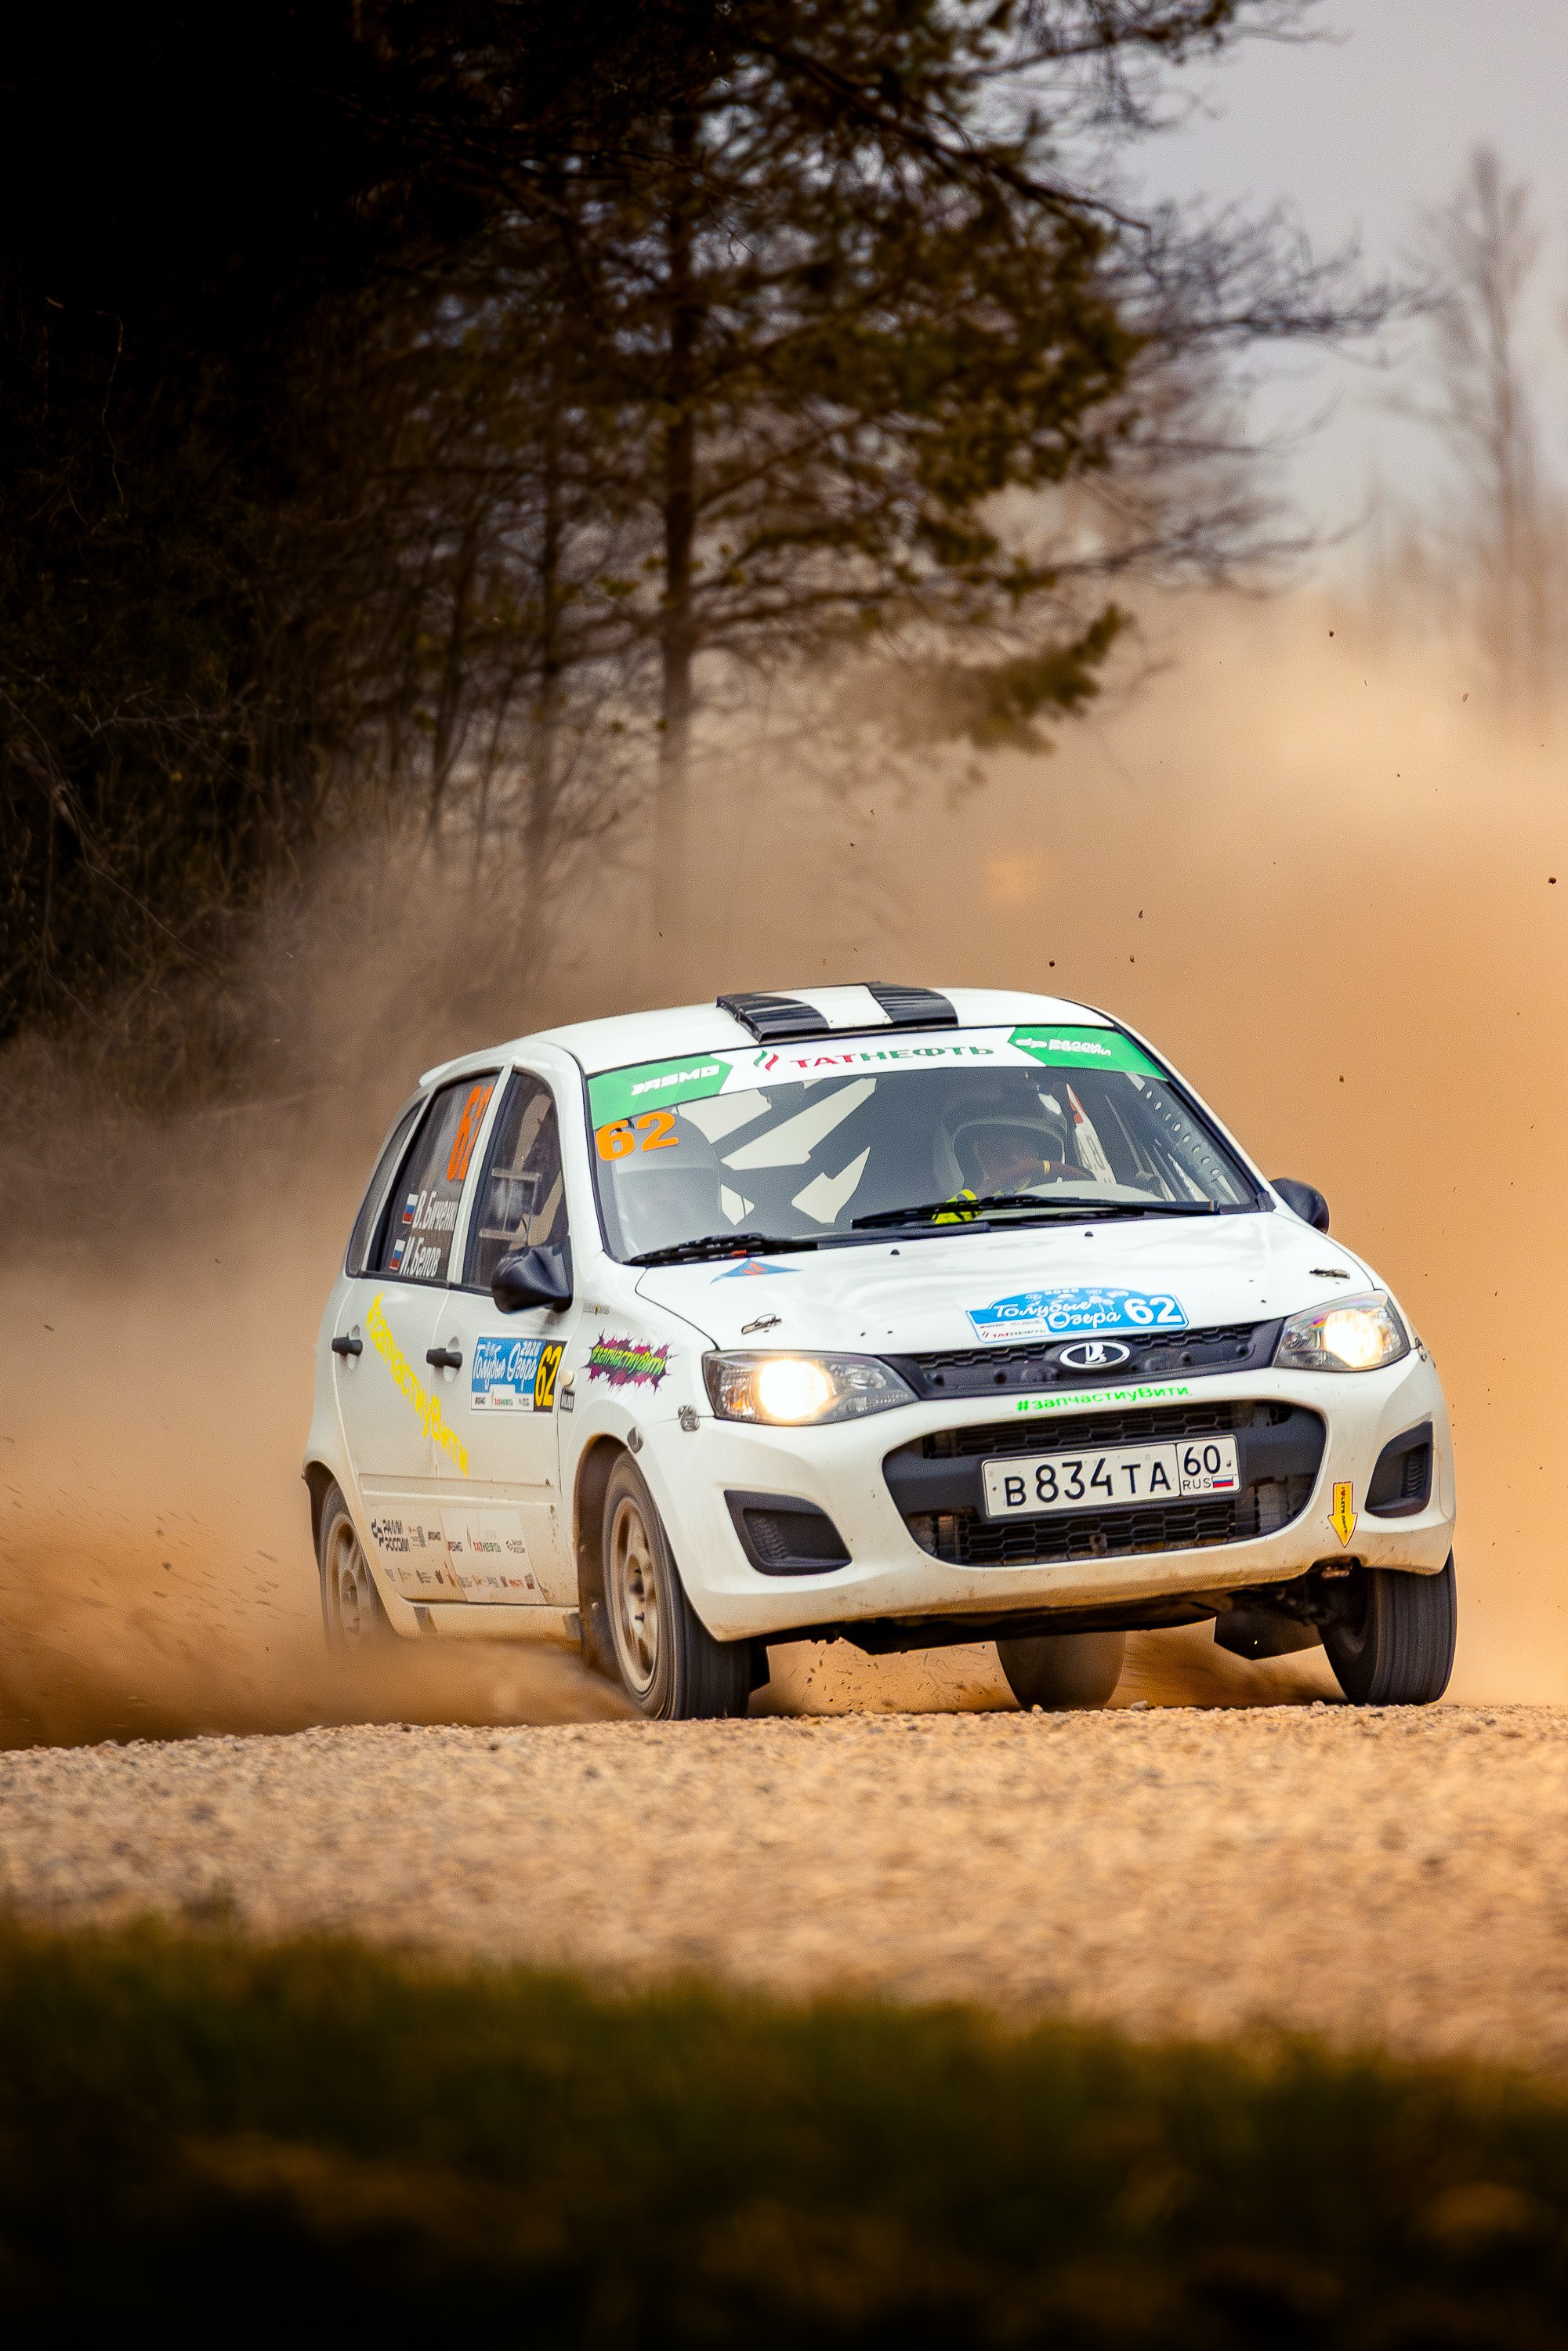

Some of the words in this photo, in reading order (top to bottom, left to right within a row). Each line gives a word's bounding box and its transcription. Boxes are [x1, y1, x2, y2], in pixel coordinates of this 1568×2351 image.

[790, 1045, 994, 1069] ТАТНЕФТЬ
[596, 1111, 681, 1161] 62
[1124, 1297, 1182, 1324] 62
[535, 1345, 563, 1407] 62
[1016, 1386, 1189, 1411] #запчастиуВити
[1184, 1445, 1220, 1475] 60
[1183, 1477, 1211, 1491] RUS
